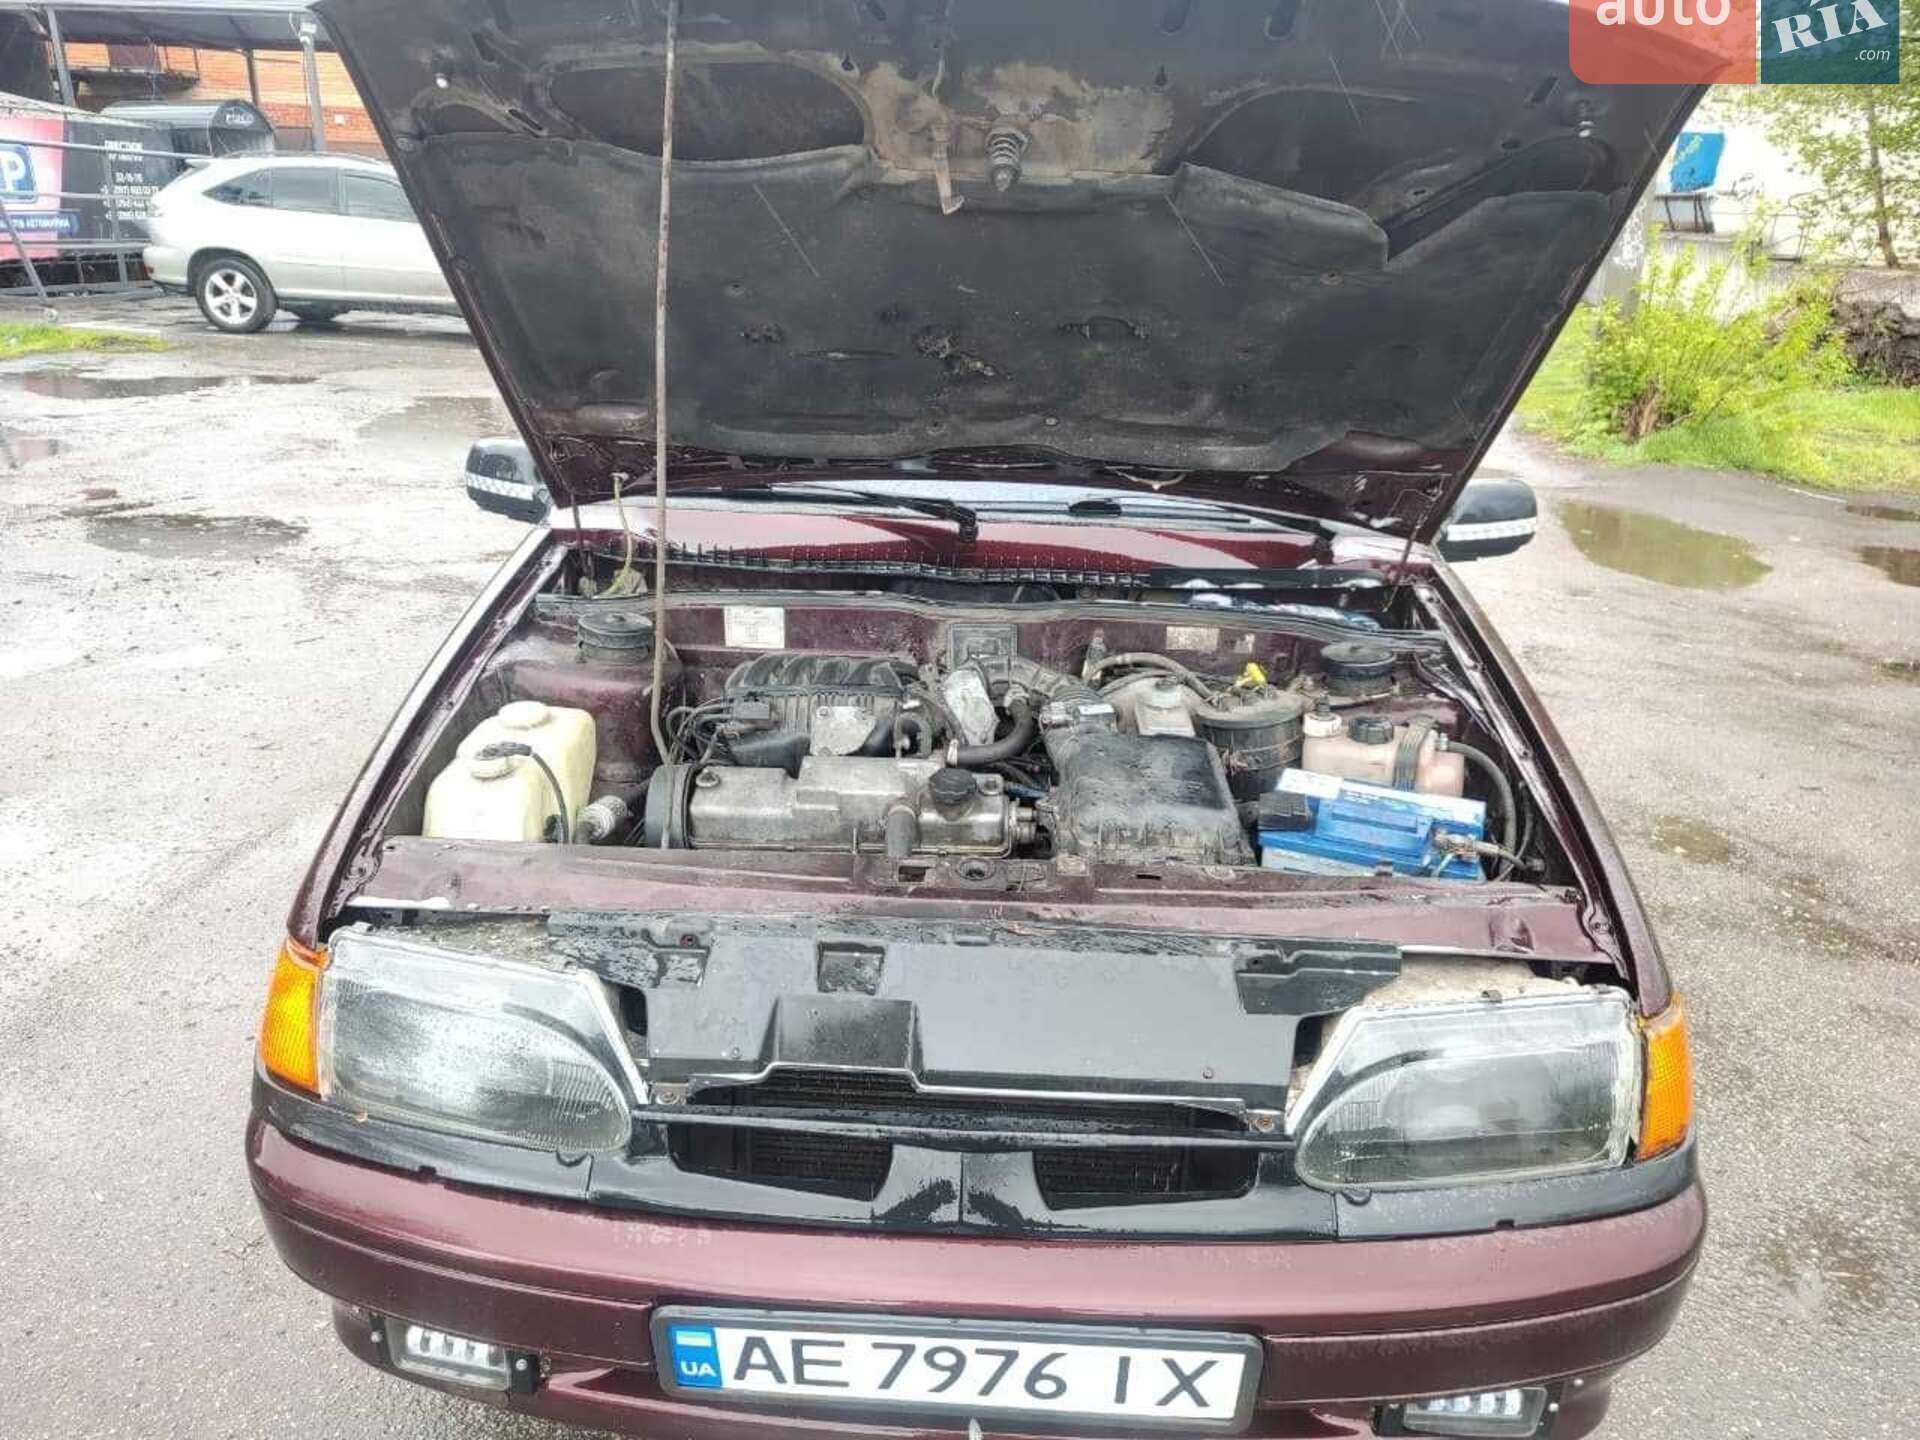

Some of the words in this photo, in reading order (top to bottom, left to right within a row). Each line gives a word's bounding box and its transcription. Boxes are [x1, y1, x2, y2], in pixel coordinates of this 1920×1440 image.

[680, 1360, 718, 1378] UA
[733, 1336, 850, 1388] AE
[871, 1341, 1069, 1400] 7976
[1113, 1355, 1220, 1408] IX
